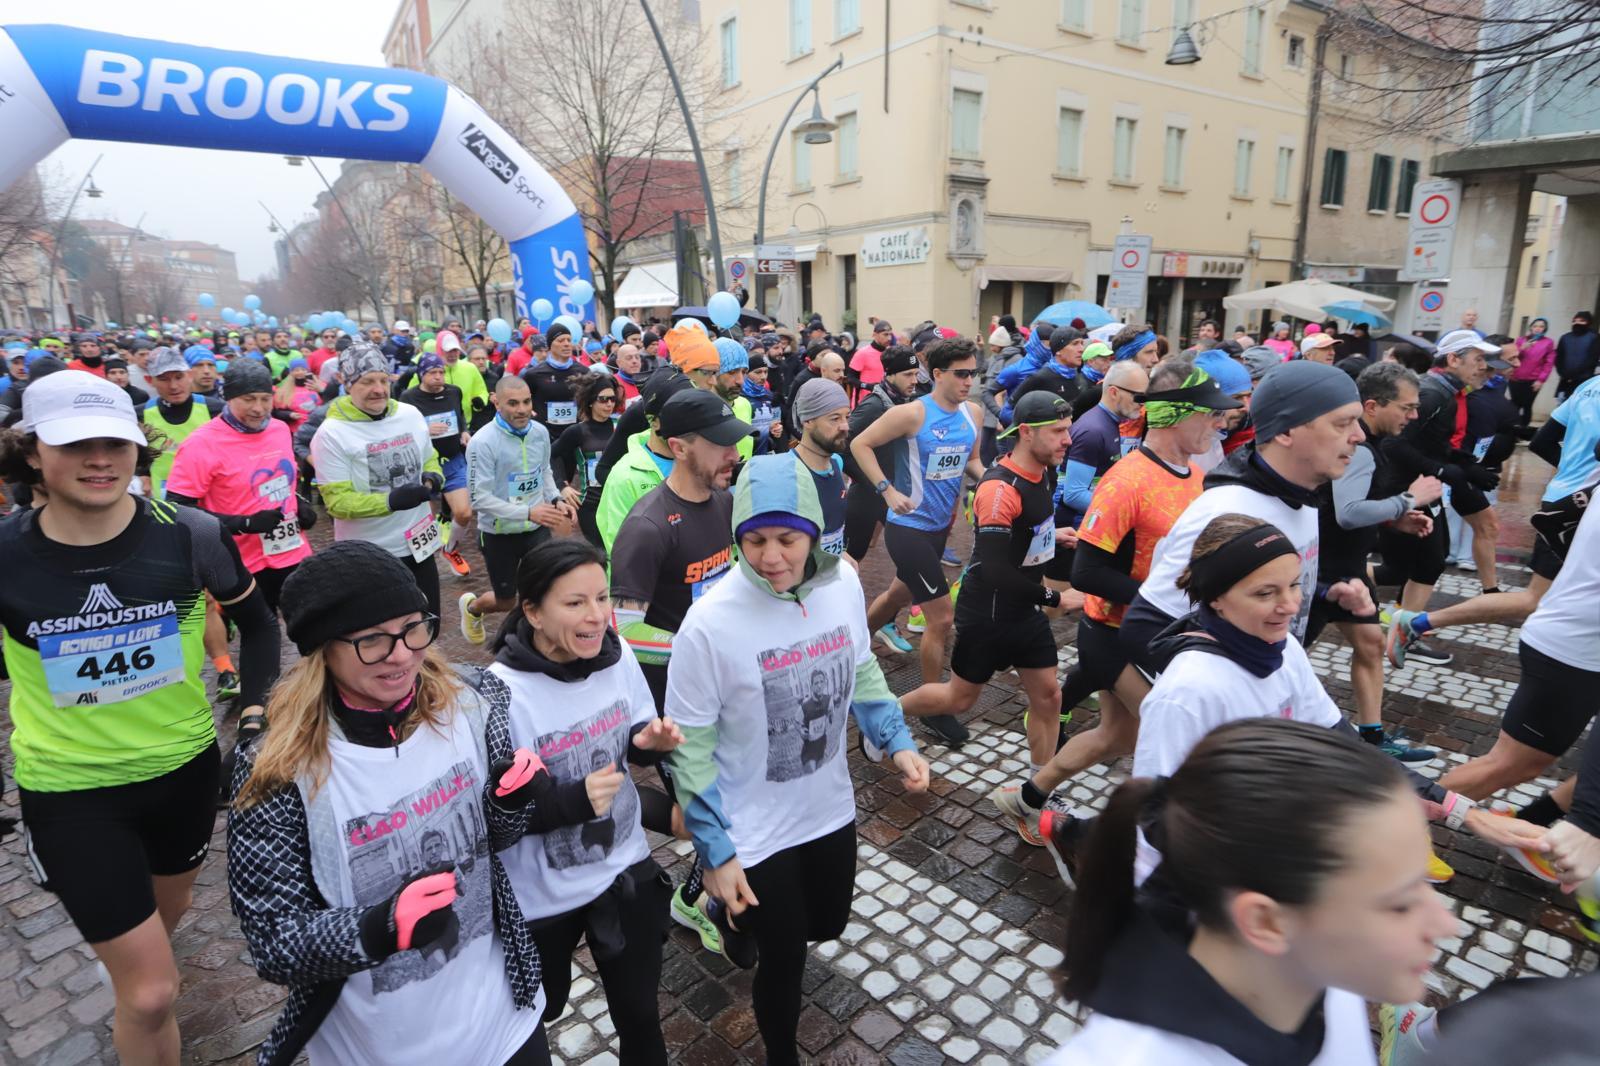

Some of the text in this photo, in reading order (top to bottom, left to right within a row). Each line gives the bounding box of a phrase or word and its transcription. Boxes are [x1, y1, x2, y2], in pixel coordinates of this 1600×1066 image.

[77, 48, 413, 132] BROOKS
[513, 175, 545, 209] Sport
[868, 247, 921, 263] NAZIONALE
[554, 408, 572, 417] 395
[937, 455, 961, 468] 490
[517, 479, 539, 492] 425
[411, 524, 438, 550] 5368
[26, 600, 177, 636] ASSINDUSTRIA
[59, 634, 114, 656] ROVIGO
[127, 624, 163, 643] LOVE
[76, 646, 156, 681] 446
[762, 649, 804, 672] CIAO
[76, 676, 168, 705] Ali BROOKS
[101, 674, 137, 687] PIETRO
[540, 730, 585, 758] CIAO
[349, 810, 408, 847] CIAO
